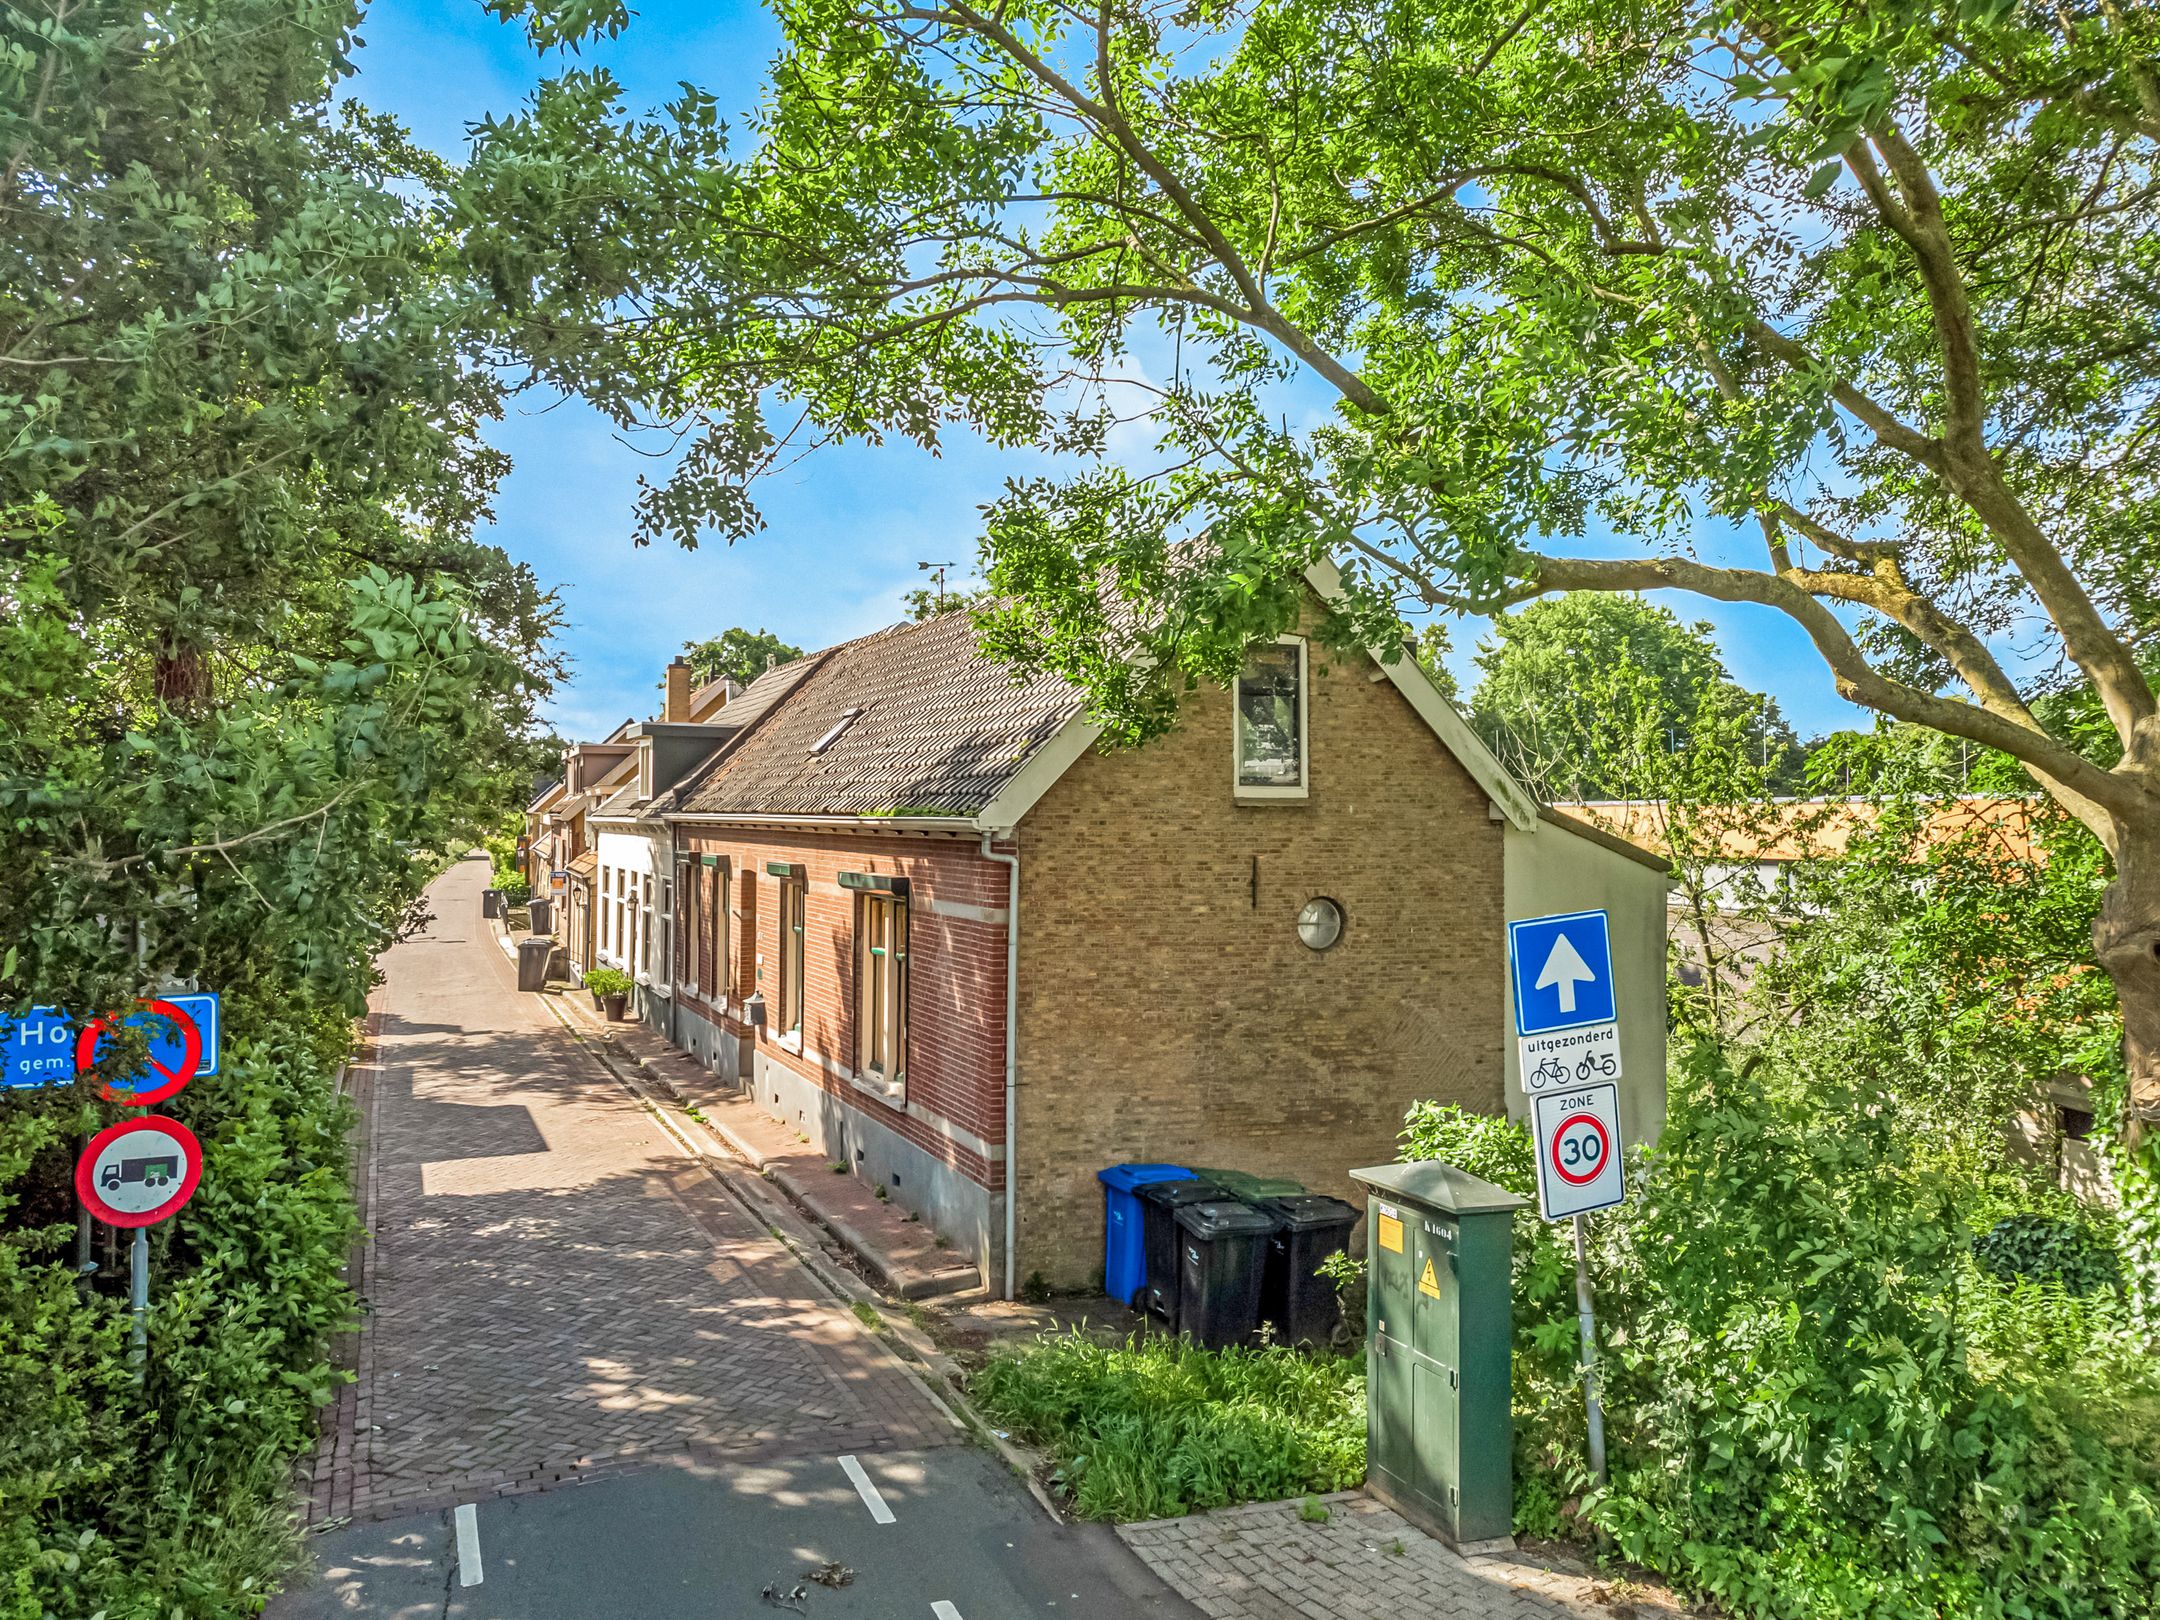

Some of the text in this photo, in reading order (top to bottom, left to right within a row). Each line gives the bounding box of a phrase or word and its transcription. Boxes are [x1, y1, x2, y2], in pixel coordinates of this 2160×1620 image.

[20, 1021, 75, 1046] Ho
[1528, 1028, 1613, 1053] uitgezonderd
[19, 1057, 71, 1075] gem.
[1560, 1094, 1594, 1111] ZONE
[1563, 1134, 1601, 1166] 30
